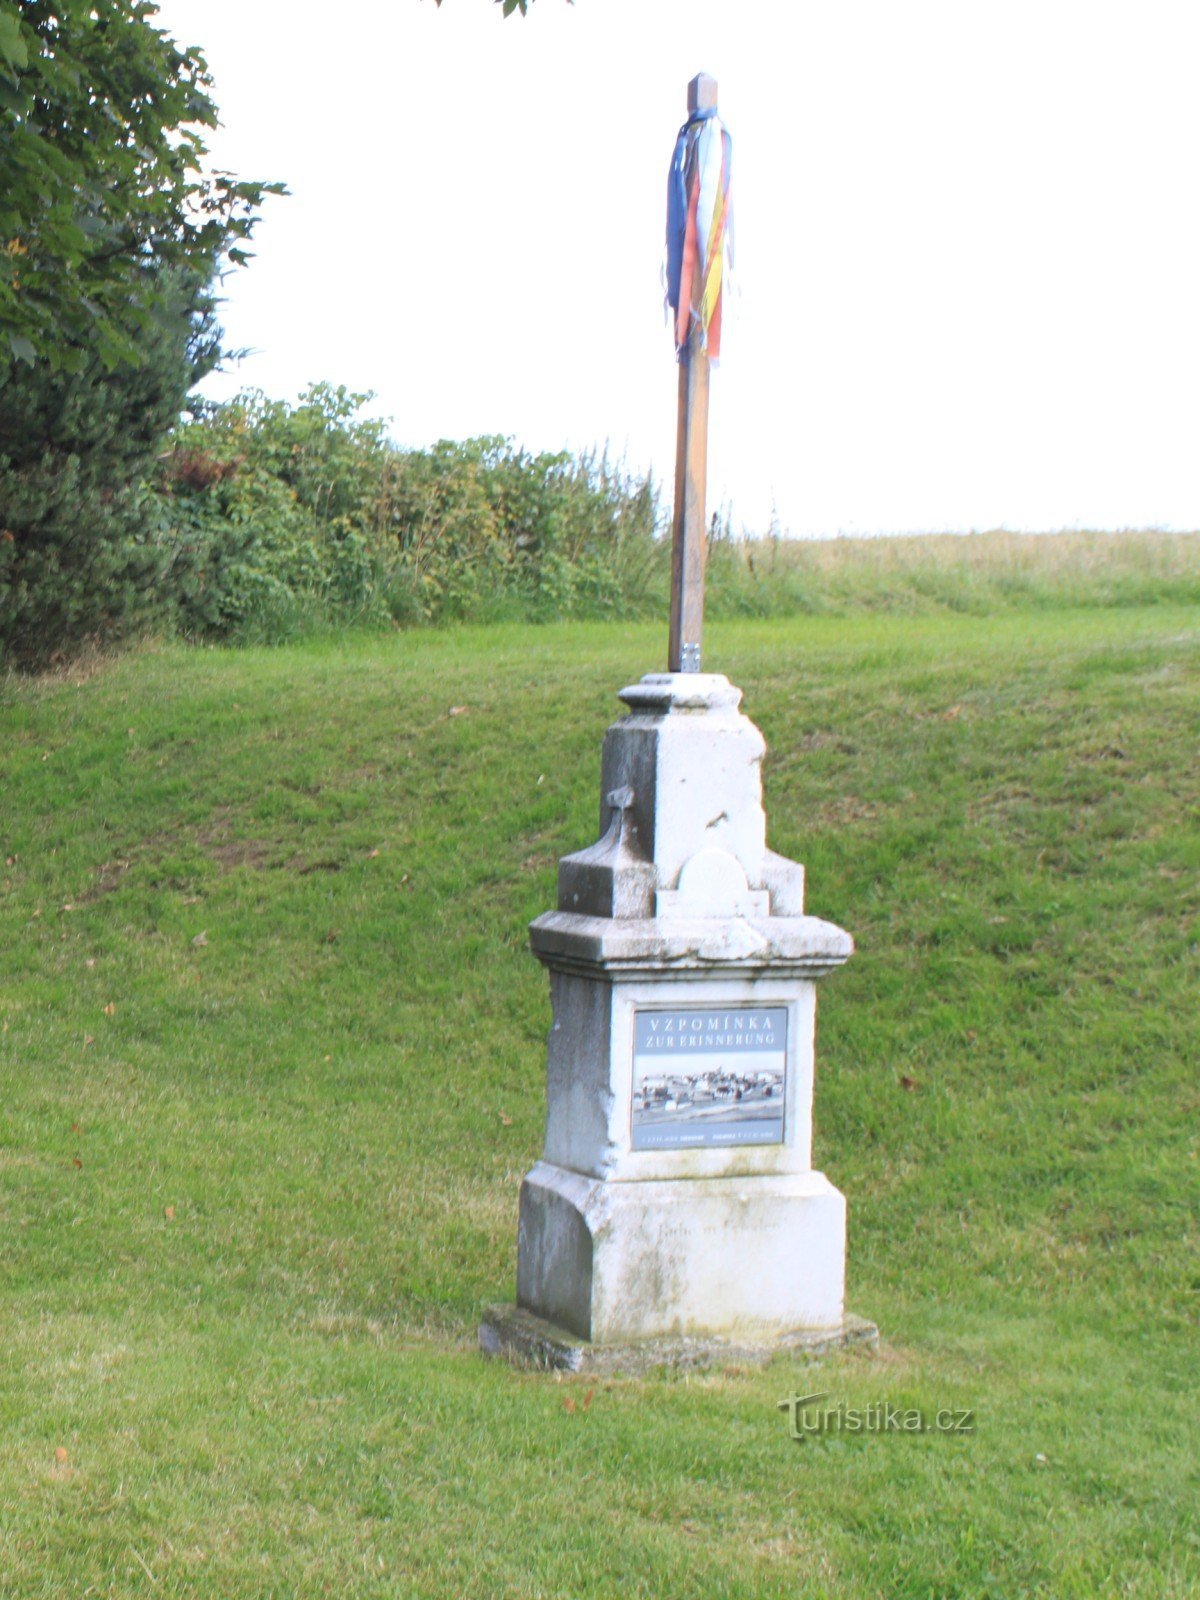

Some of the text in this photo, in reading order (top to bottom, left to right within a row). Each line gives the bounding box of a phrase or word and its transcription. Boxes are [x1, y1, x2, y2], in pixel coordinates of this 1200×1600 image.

[650, 1014, 772, 1032] VZPOMÍNKA
[646, 1032, 775, 1048] ZUR ERINNERUNG
